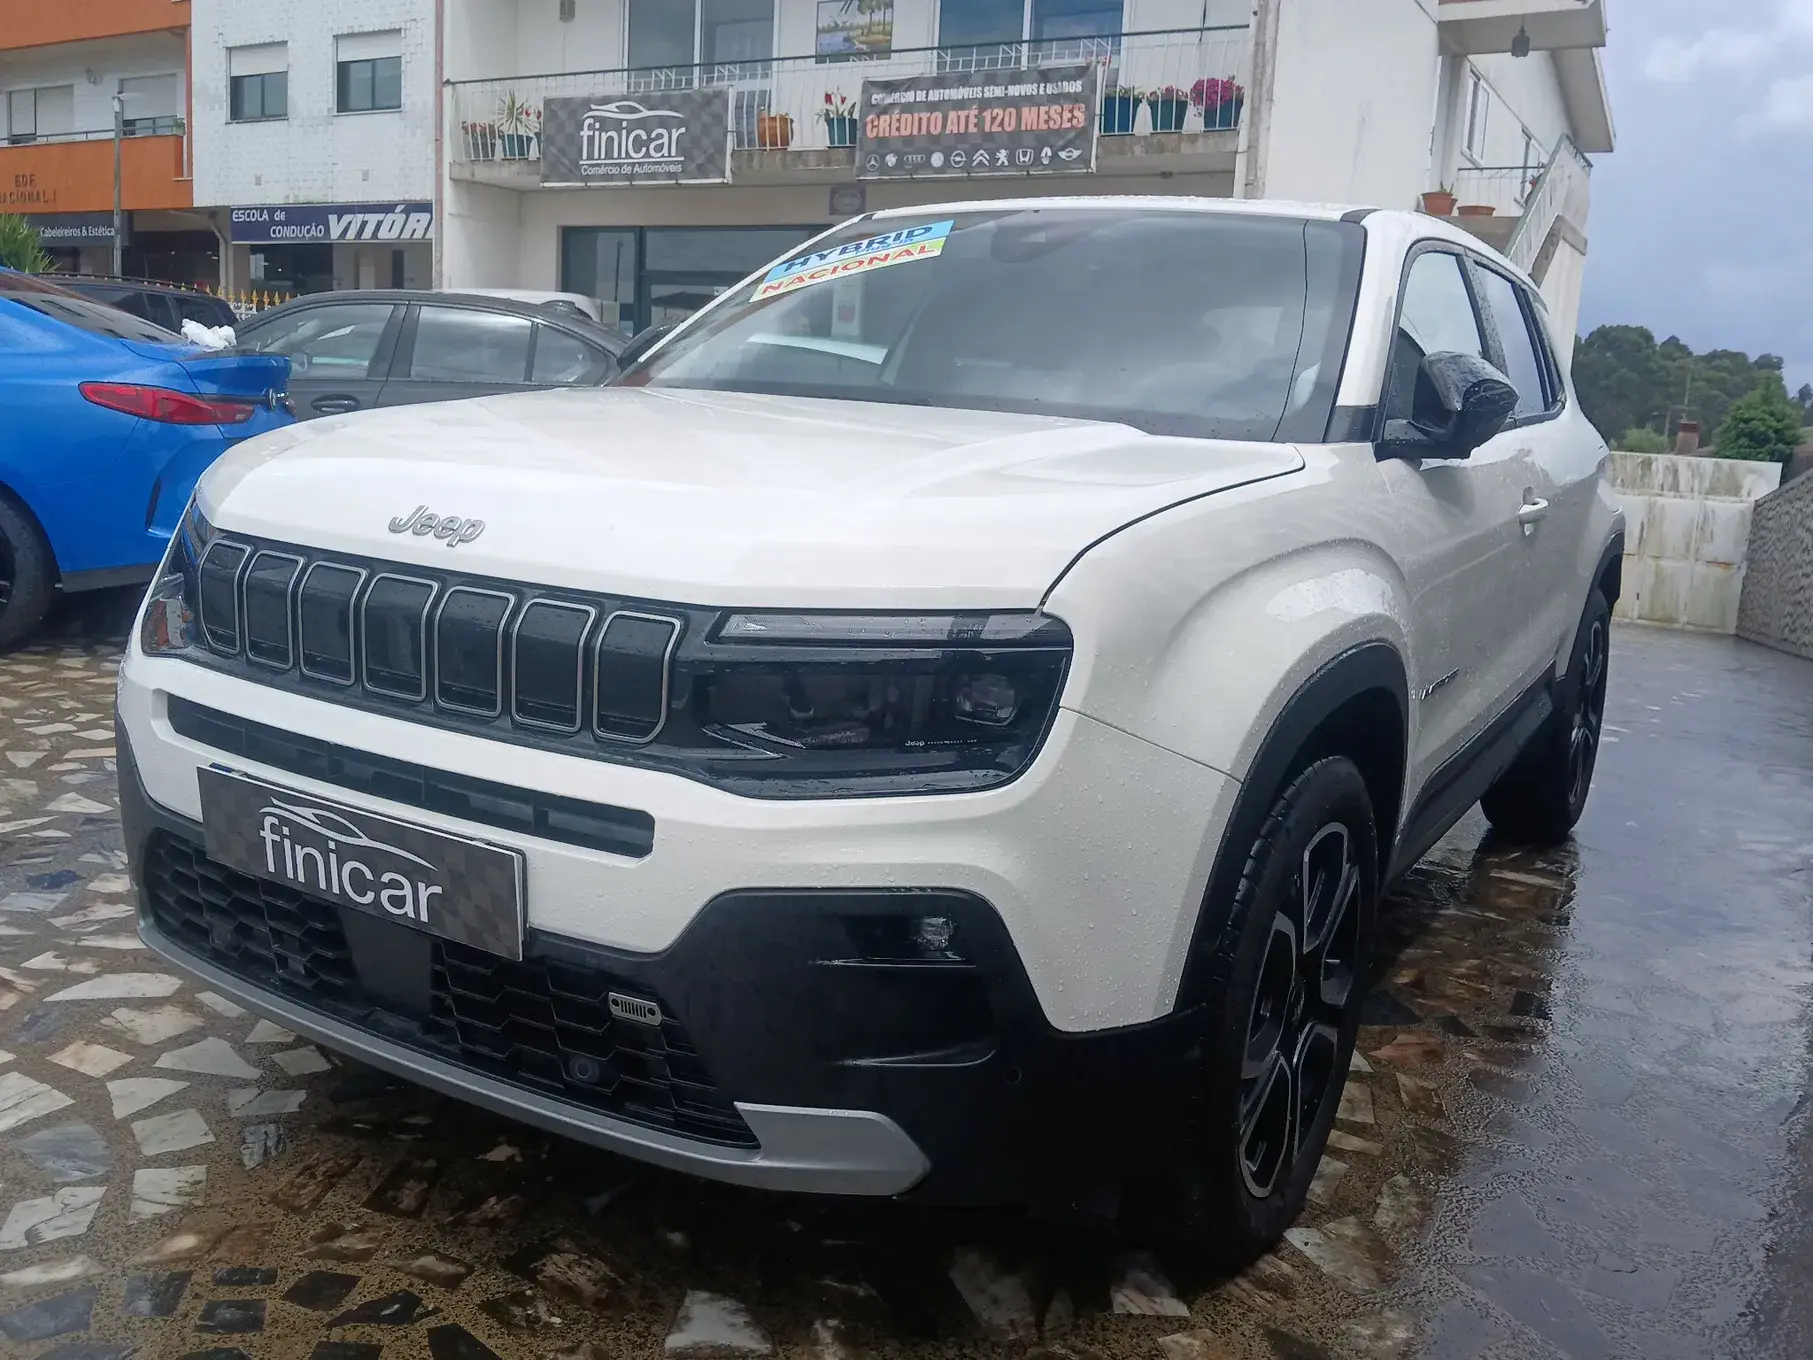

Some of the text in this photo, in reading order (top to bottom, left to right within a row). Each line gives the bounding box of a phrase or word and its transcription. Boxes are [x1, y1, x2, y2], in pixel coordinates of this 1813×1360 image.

[916, 90, 927, 102] DE
[927, 86, 982, 101] AUTOMÓVEIS
[983, 83, 1038, 98] SEMI-NOVOS
[1039, 83, 1045, 95] E
[1046, 80, 1083, 95] USADOS
[580, 118, 686, 160] finicar
[866, 103, 1086, 139] CRÉDITO ATÉ 120 MESES
[581, 162, 682, 175] Comércio de Automóveis
[81, 226, 88, 237] &
[88, 225, 115, 237] Estética
[232, 209, 285, 222] ESCOLA de
[270, 222, 325, 240] CONDUÇÃO
[328, 204, 433, 240] VITÓR
[784, 226, 933, 273] HYBRID
[760, 245, 936, 295] NACIONAL
[388, 504, 486, 548] Jeep
[259, 815, 443, 923] finicar
